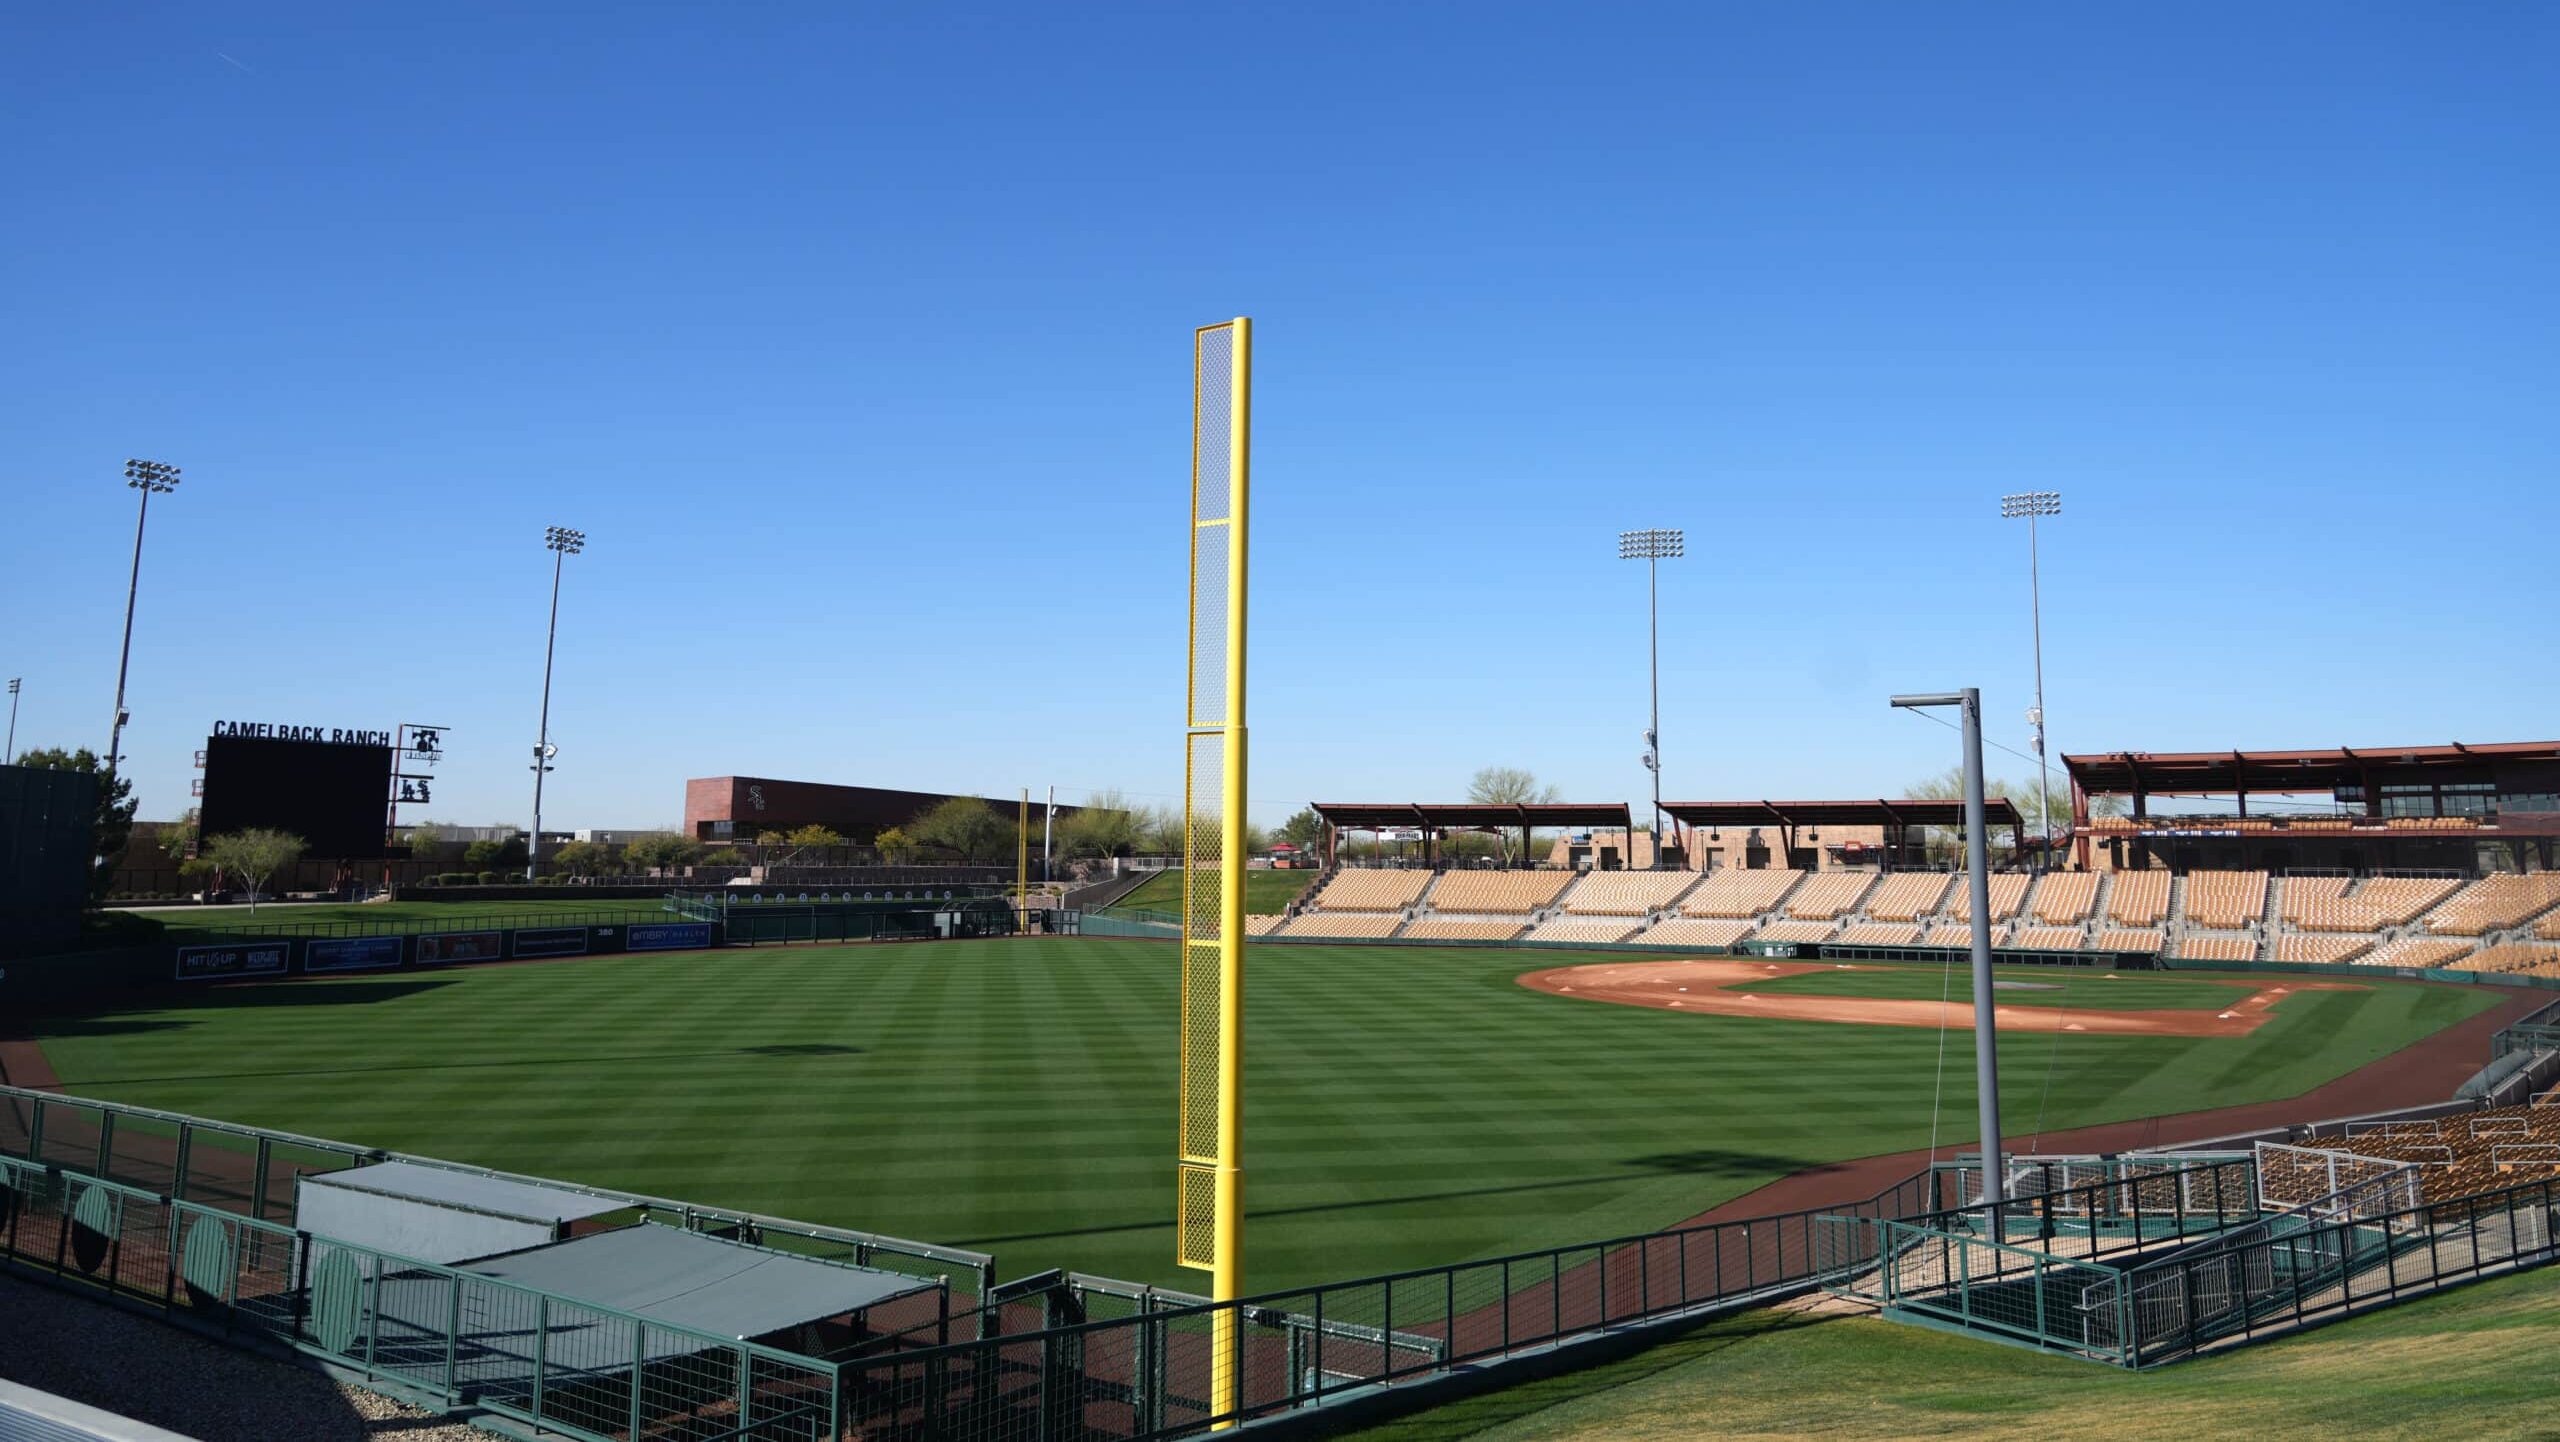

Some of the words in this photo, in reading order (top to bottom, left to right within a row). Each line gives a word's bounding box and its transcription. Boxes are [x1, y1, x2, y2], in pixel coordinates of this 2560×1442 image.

[213, 720, 325, 742] CAMELBACK
[332, 729, 390, 747] RANCH
[186, 954, 205, 967] HIT
[220, 953, 237, 965] UP
